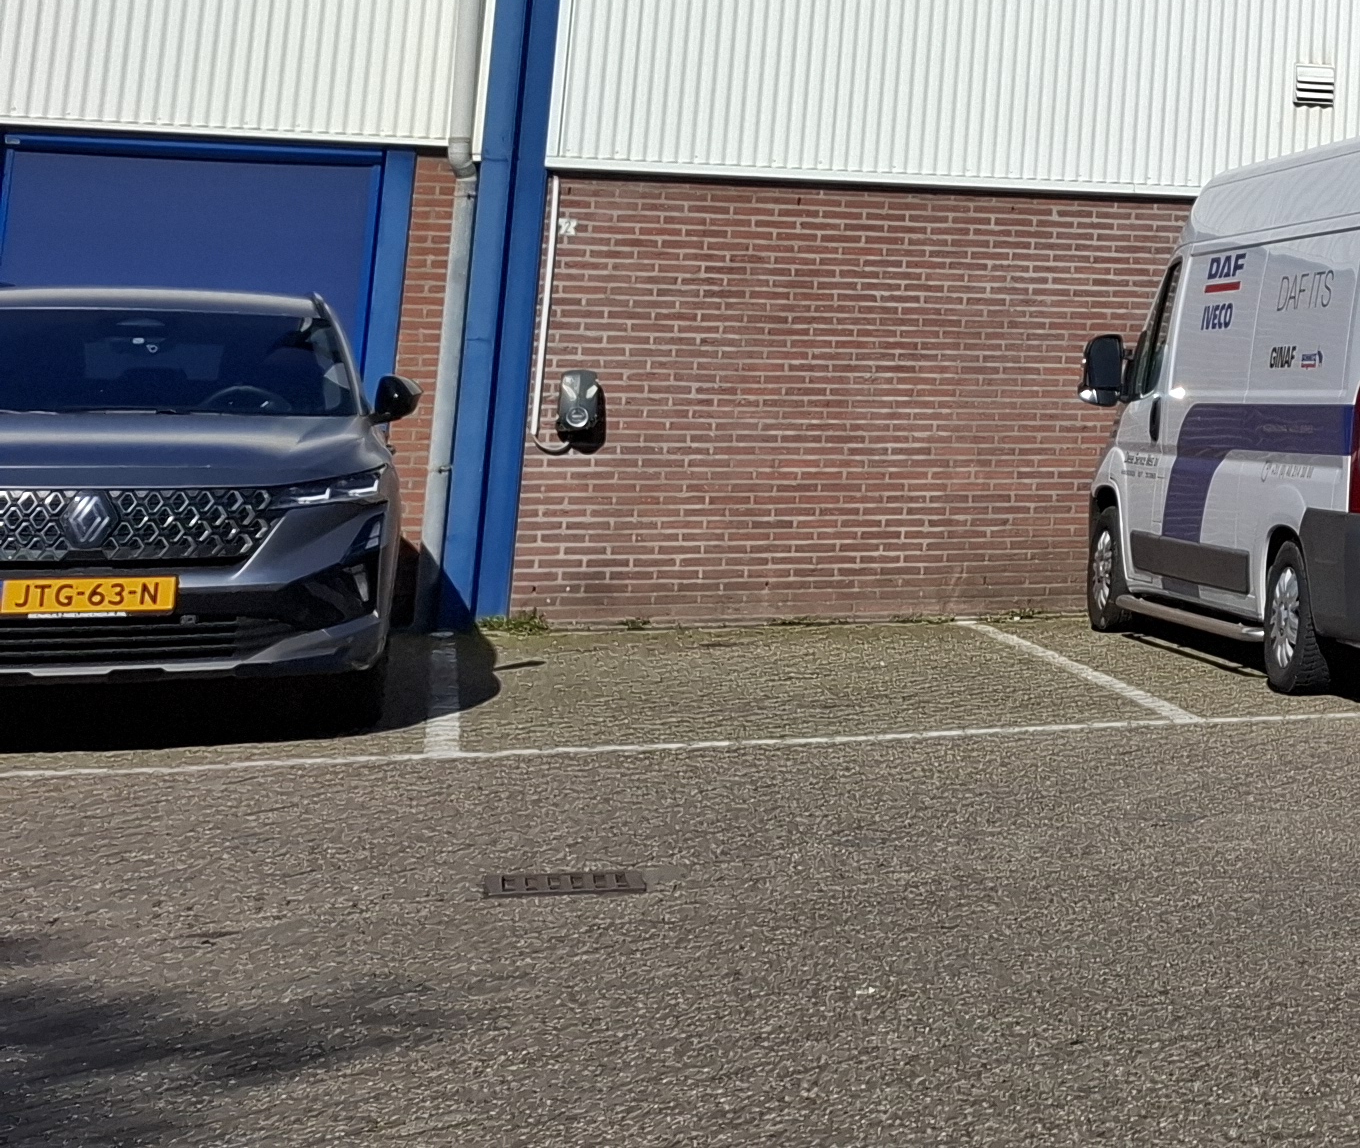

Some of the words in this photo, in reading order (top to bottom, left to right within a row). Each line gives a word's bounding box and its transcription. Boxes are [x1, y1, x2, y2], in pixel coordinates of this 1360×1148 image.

[1207, 252, 1247, 280] DAF
[1276, 273, 1310, 312] DAF
[1308, 269, 1335, 308] ITS
[1201, 302, 1234, 330] IVECO
[1270, 345, 1297, 368] GINAF
[14, 581, 160, 608] JTG-63-N
